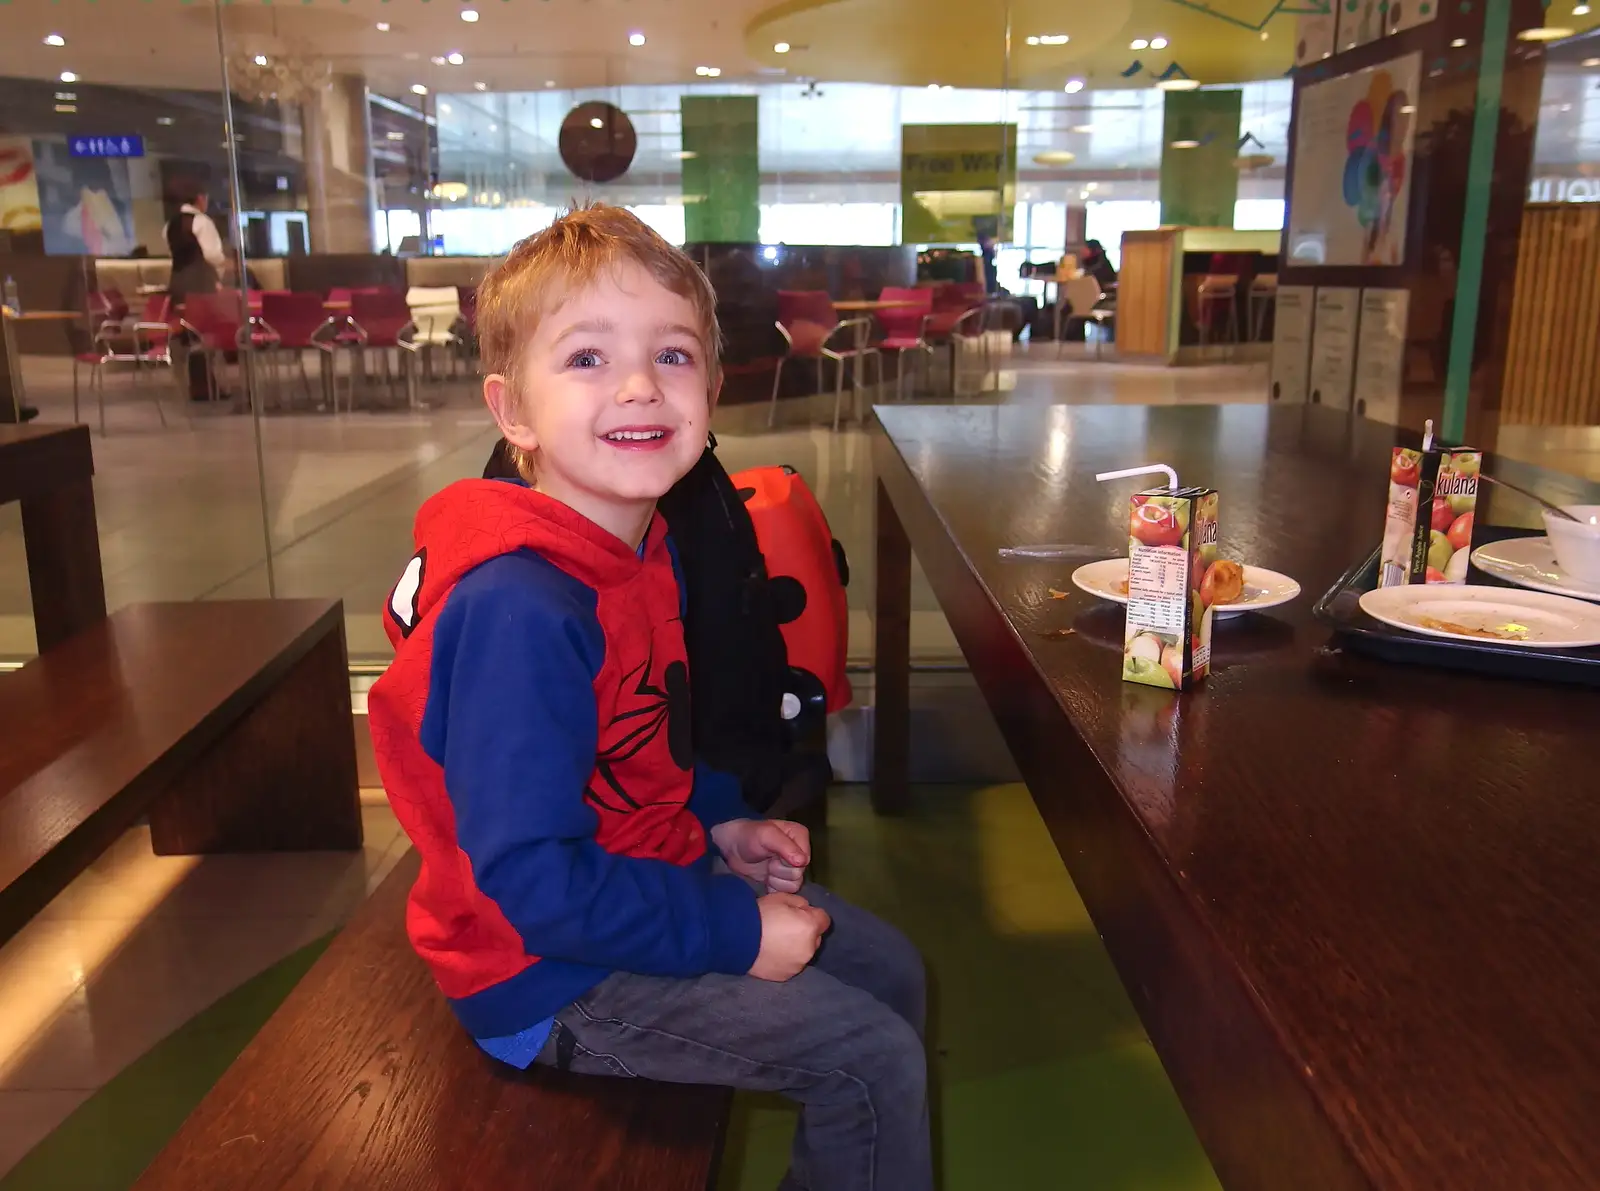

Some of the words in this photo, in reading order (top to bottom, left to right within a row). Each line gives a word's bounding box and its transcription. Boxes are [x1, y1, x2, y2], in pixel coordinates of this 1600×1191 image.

[905, 153, 955, 174] Free
[960, 152, 1005, 174] Wi-F
[1436, 473, 1476, 495] kulana
